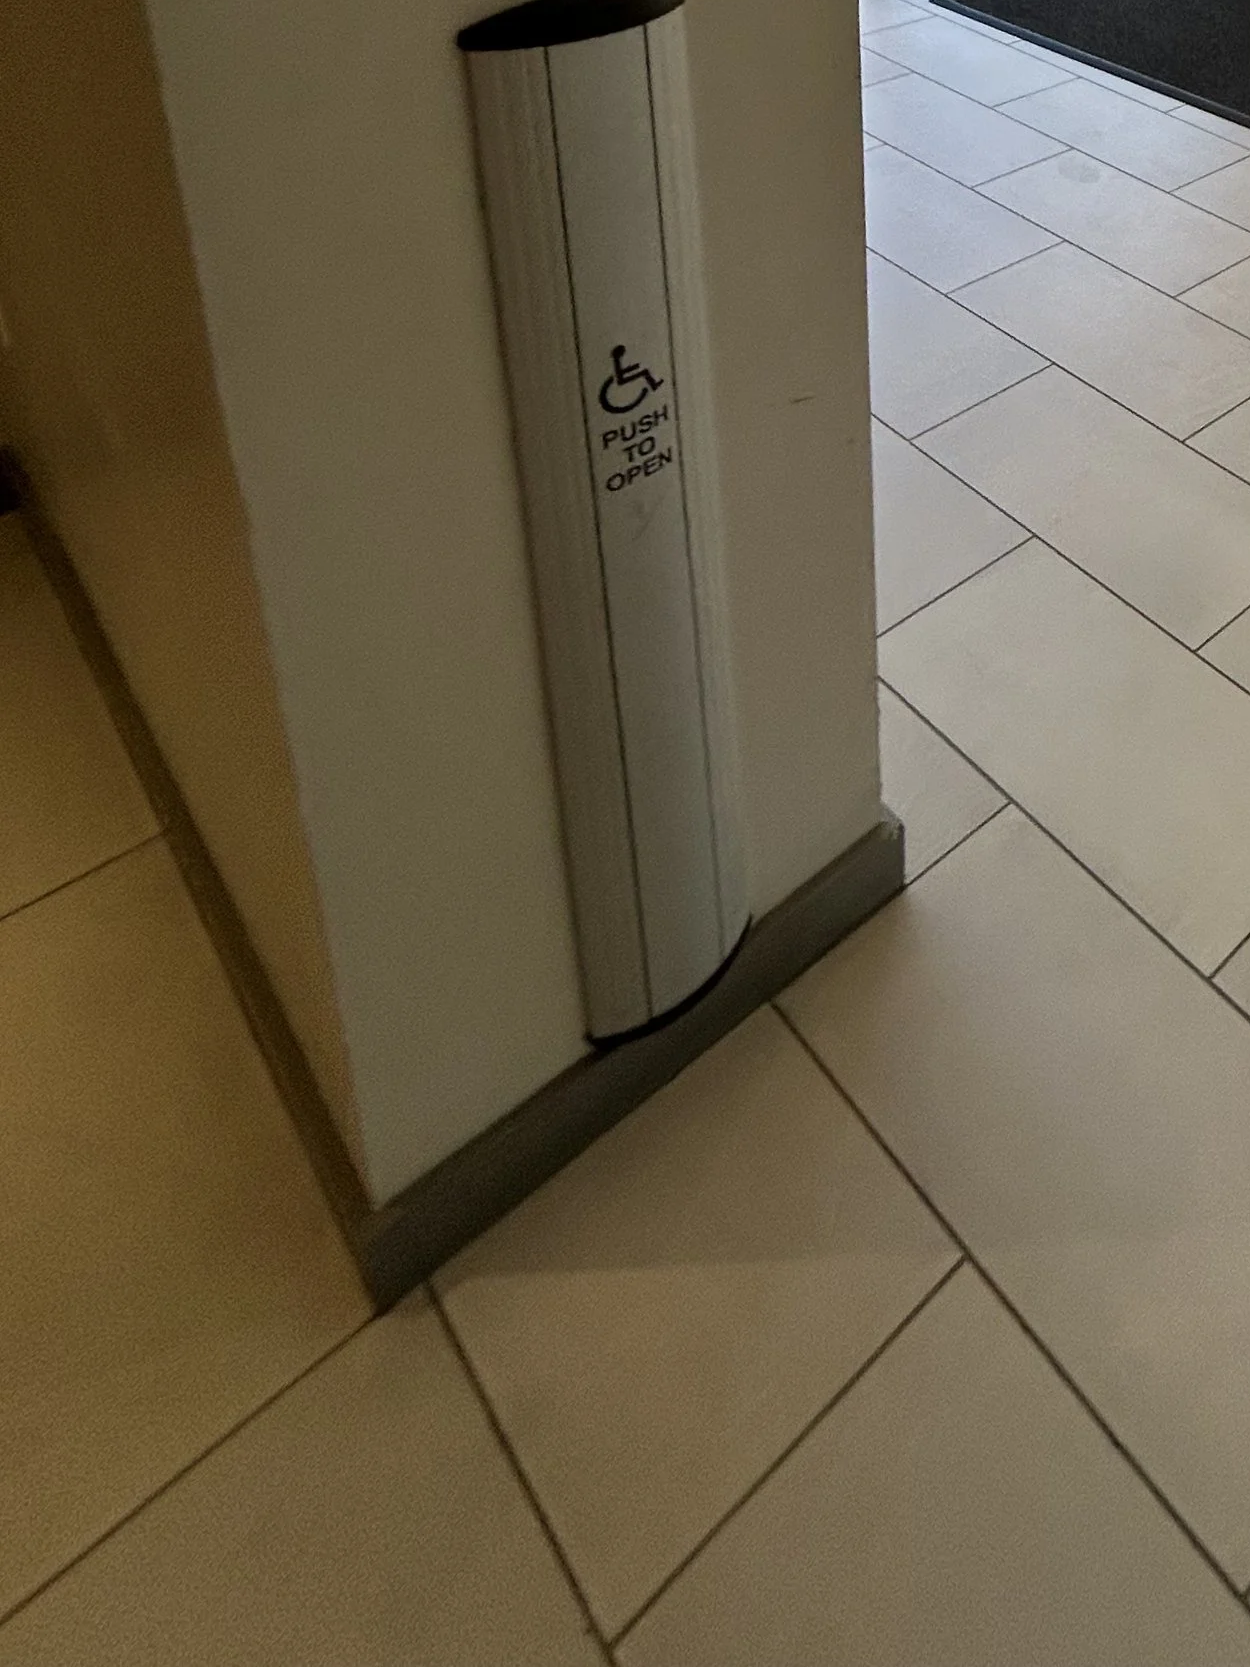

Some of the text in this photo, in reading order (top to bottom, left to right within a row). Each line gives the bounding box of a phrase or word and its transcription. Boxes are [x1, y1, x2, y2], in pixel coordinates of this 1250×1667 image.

[602, 404, 669, 450] PUSH
[622, 436, 656, 463] TO
[606, 447, 673, 492] OPEN
